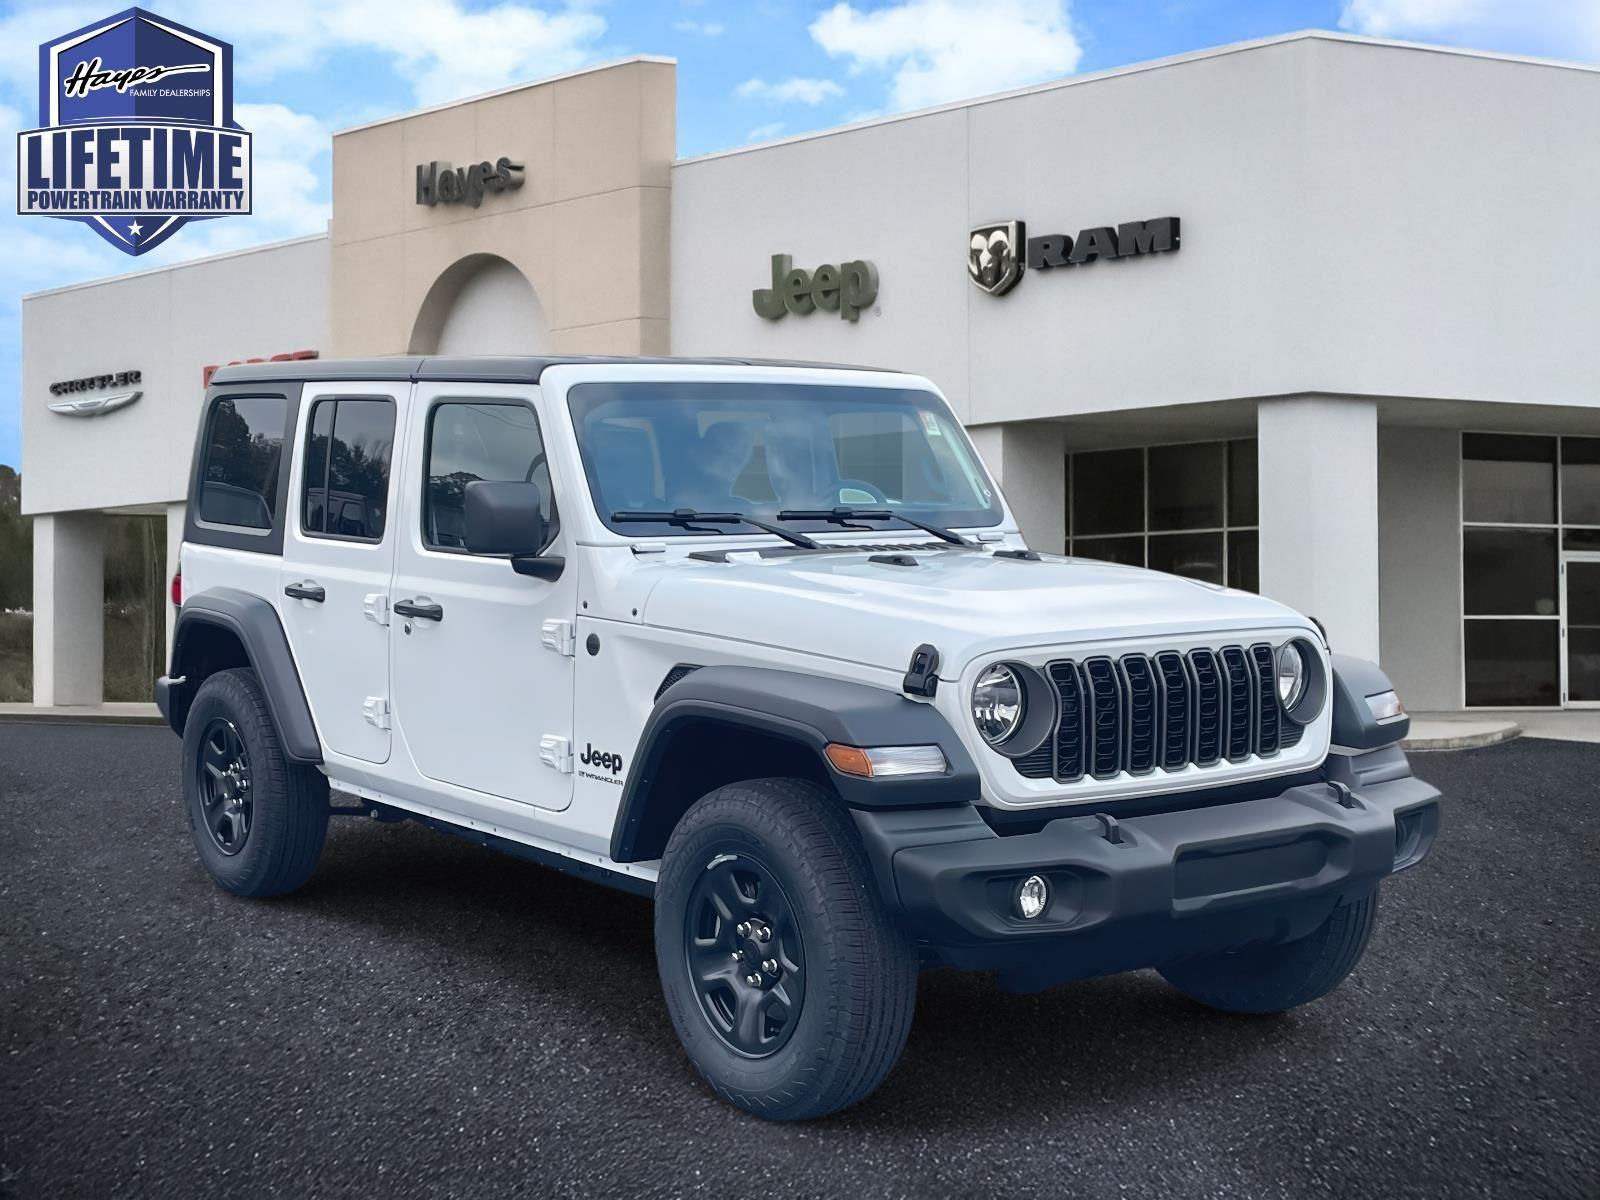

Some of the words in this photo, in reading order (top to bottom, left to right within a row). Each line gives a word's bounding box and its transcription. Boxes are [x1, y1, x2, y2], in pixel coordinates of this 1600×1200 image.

[416, 157, 526, 209] Hayes
[1027, 216, 1181, 268] RAM
[752, 253, 880, 324] Jeep
[49, 370, 142, 395] CHRYSLER
[580, 743, 623, 775] Jeep
[585, 772, 624, 786] WRANGLER
